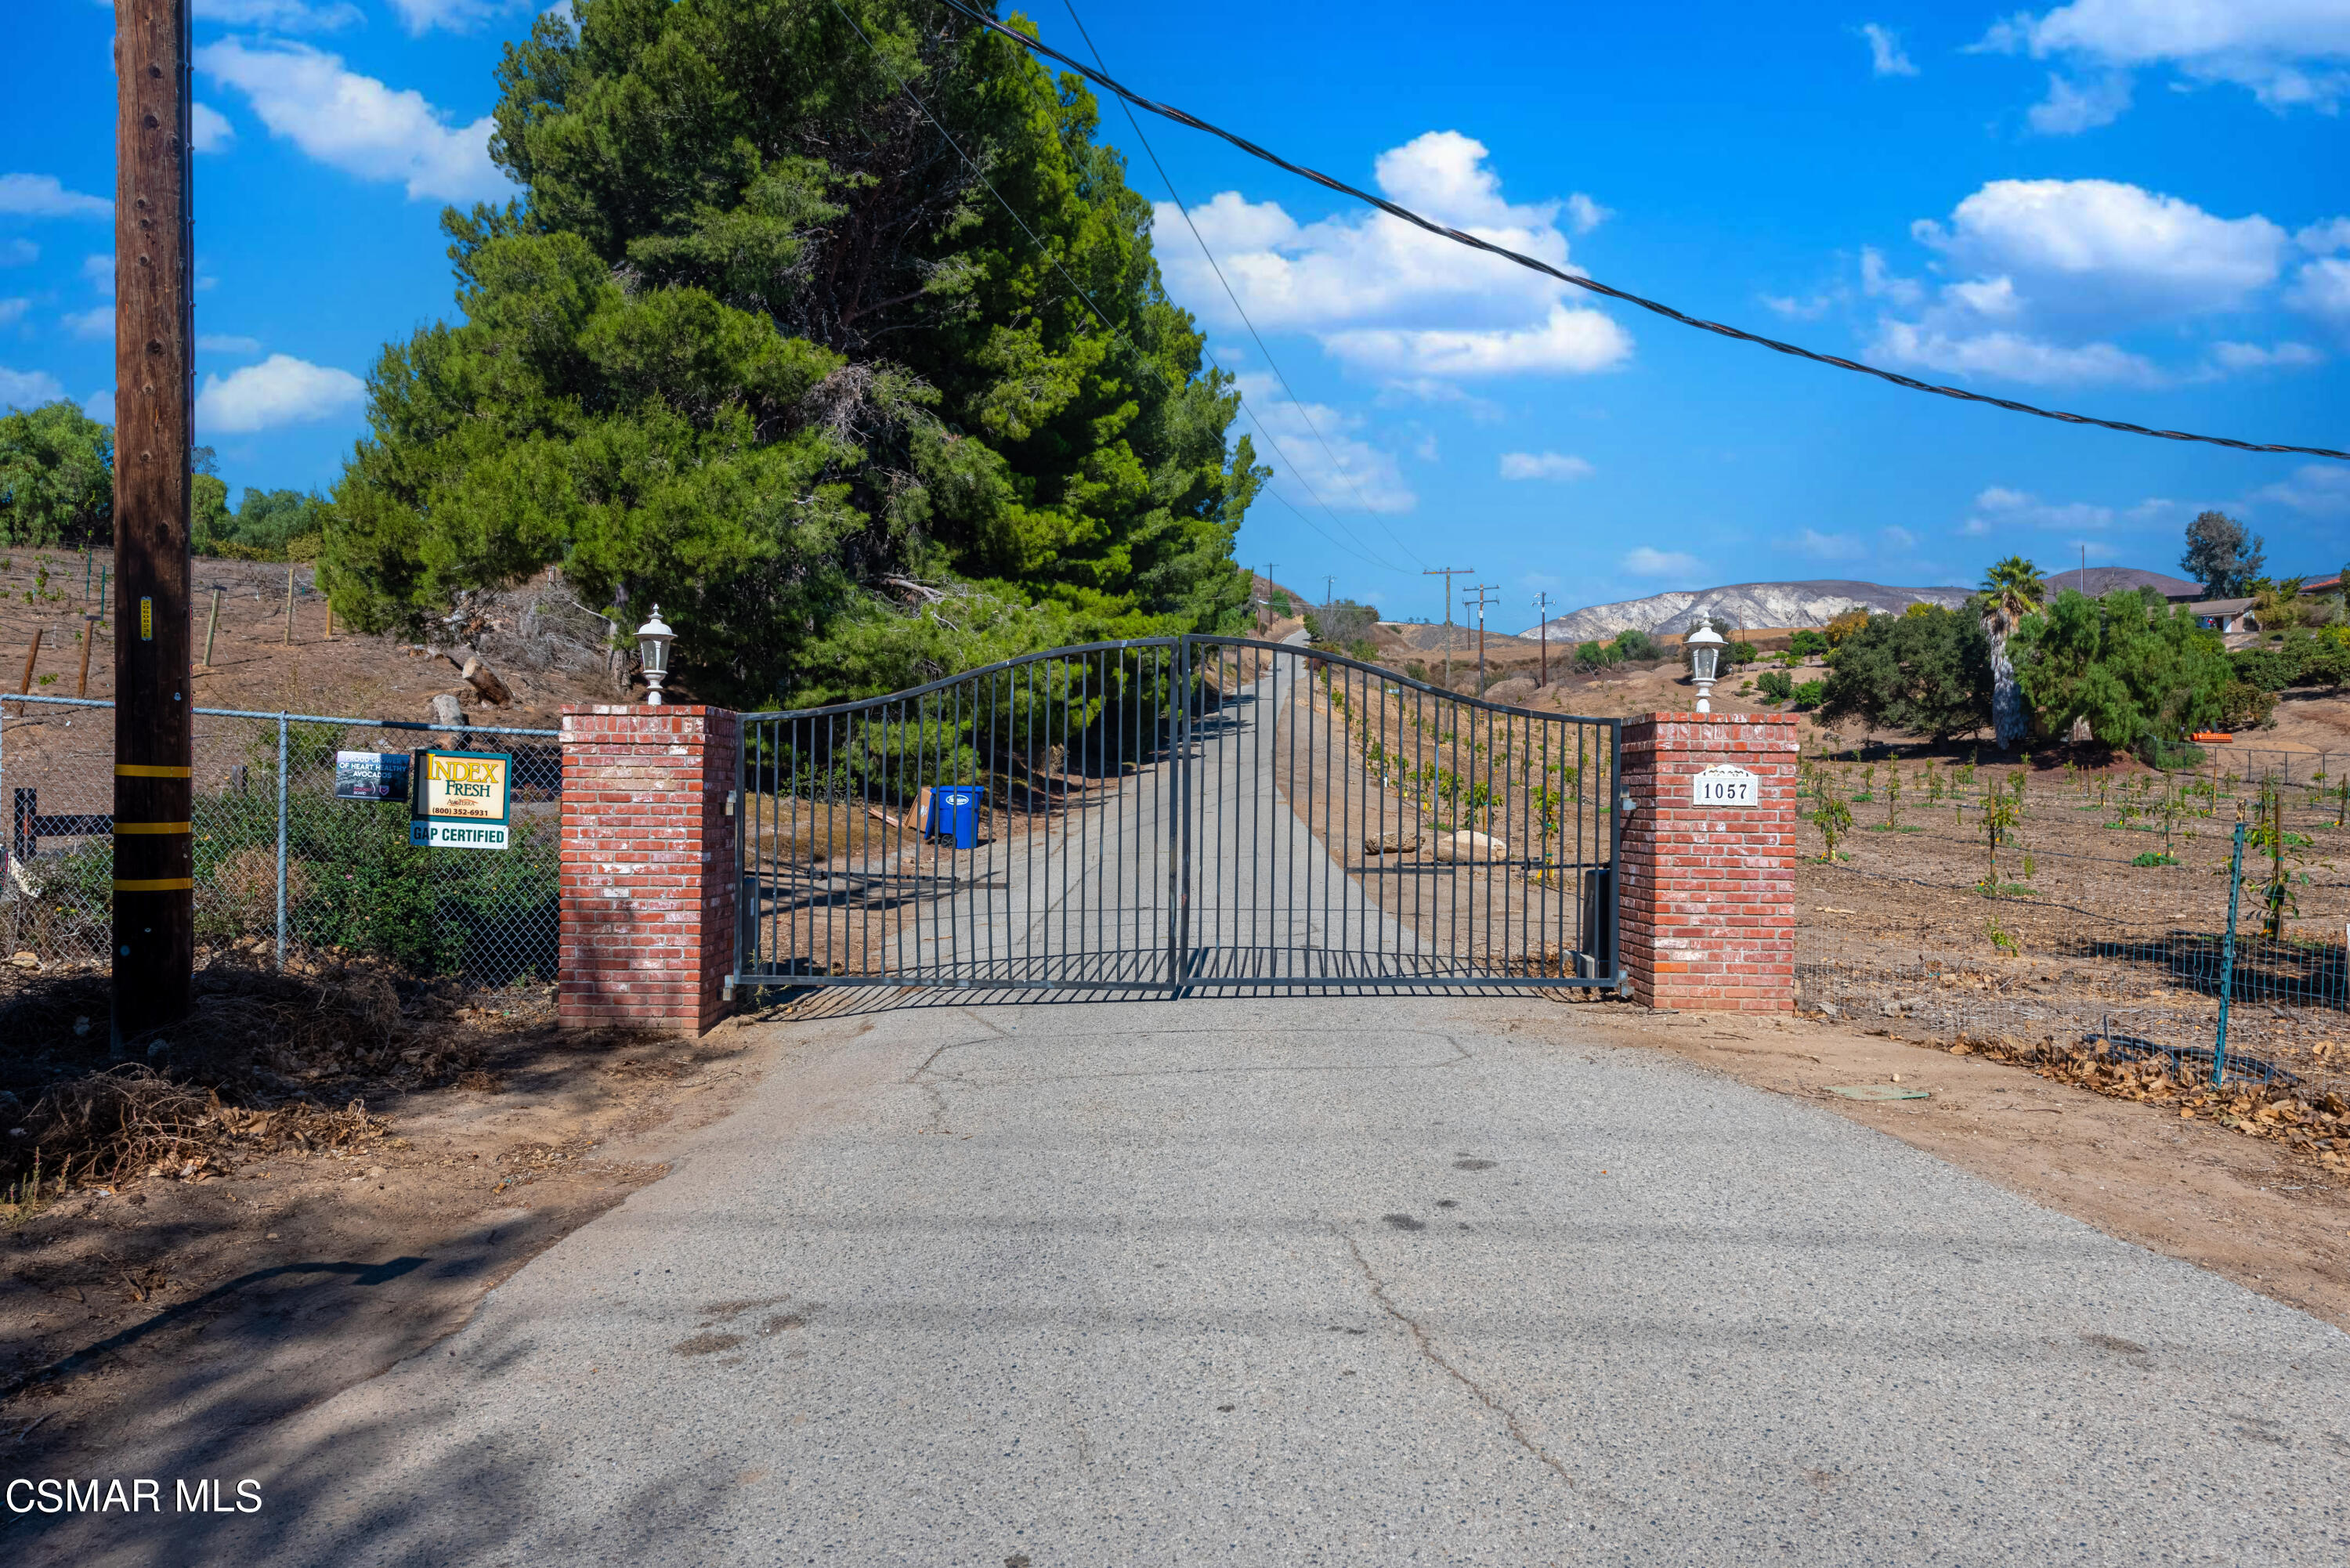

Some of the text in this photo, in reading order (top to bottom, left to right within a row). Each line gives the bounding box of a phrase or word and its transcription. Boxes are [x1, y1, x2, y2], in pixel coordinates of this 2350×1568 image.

[425, 753, 498, 783] INDEX
[445, 780, 490, 797] FRESH
[1705, 783, 1747, 799] 1057
[414, 826, 504, 843] GAP CERTIFIED
